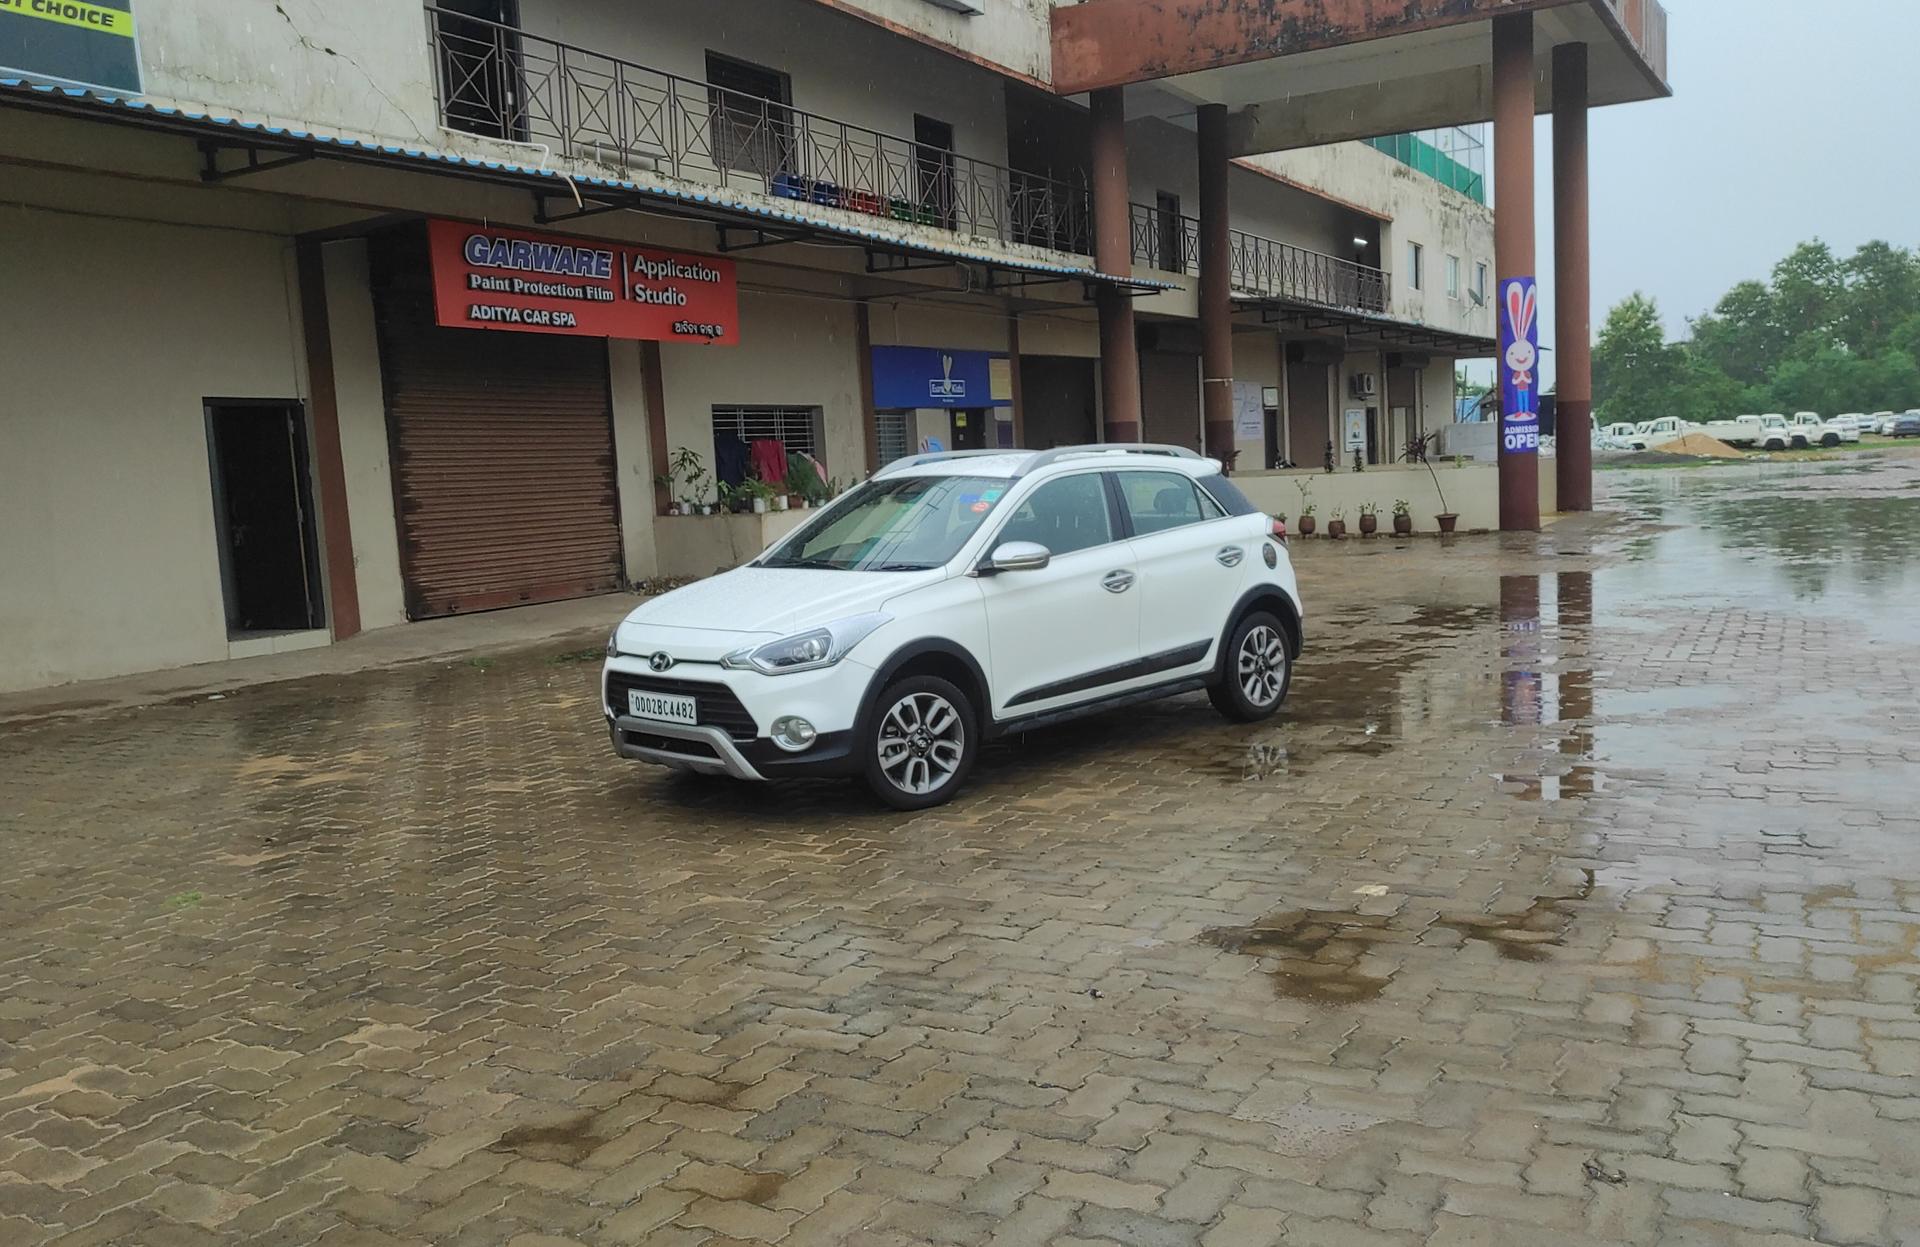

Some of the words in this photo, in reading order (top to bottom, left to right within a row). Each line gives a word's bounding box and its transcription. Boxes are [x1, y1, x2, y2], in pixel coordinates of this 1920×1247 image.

[31, 0, 114, 27] CHOICE
[465, 234, 613, 280] GARWARE
[633, 254, 720, 282] Application
[471, 273, 511, 291] Paint
[513, 278, 583, 299] Protection
[586, 286, 614, 301] Film
[634, 283, 687, 306] Studio
[471, 304, 521, 323] ADITYA
[523, 309, 550, 325] CAR
[552, 311, 577, 327] SPA
[635, 695, 694, 720] OD02BC4482
